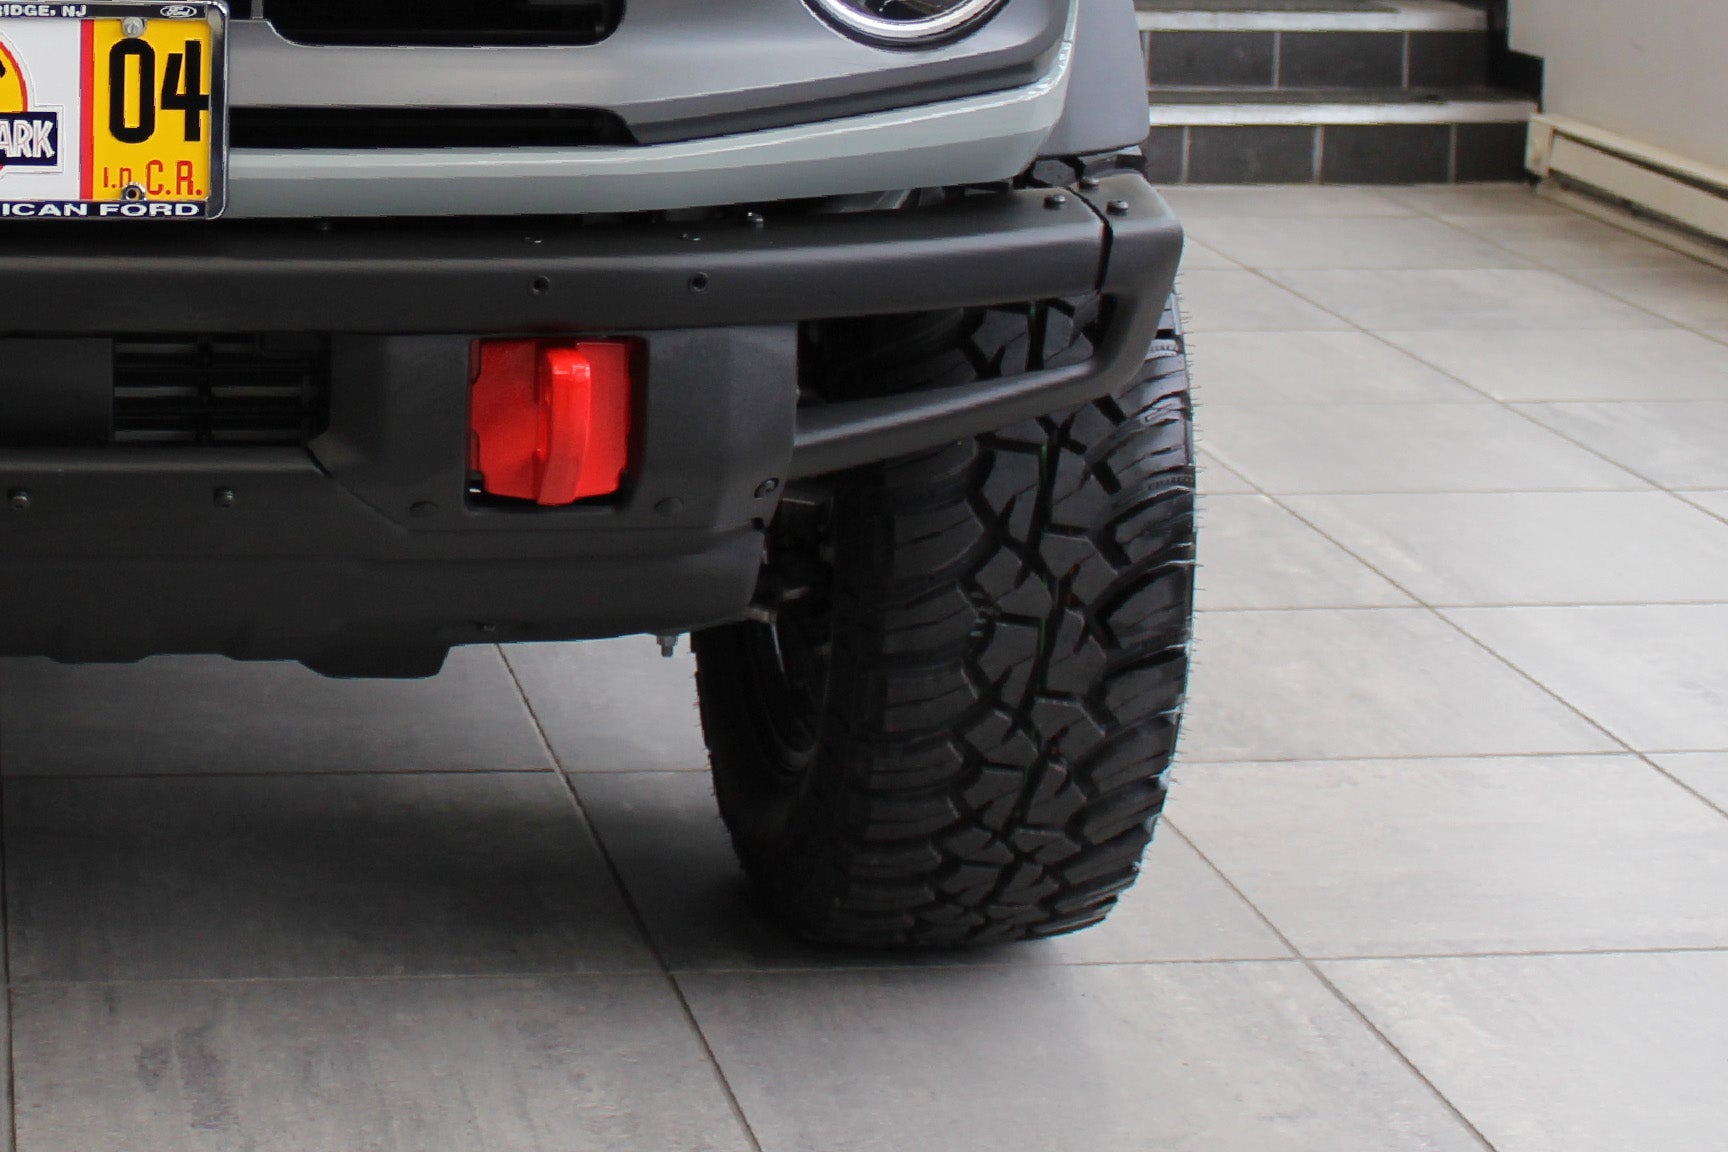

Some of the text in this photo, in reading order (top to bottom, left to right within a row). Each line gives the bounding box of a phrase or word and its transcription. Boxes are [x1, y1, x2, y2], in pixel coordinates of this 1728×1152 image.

[62, 4, 87, 17] NJ
[109, 38, 209, 144] 04
[99, 203, 199, 216] FORD
